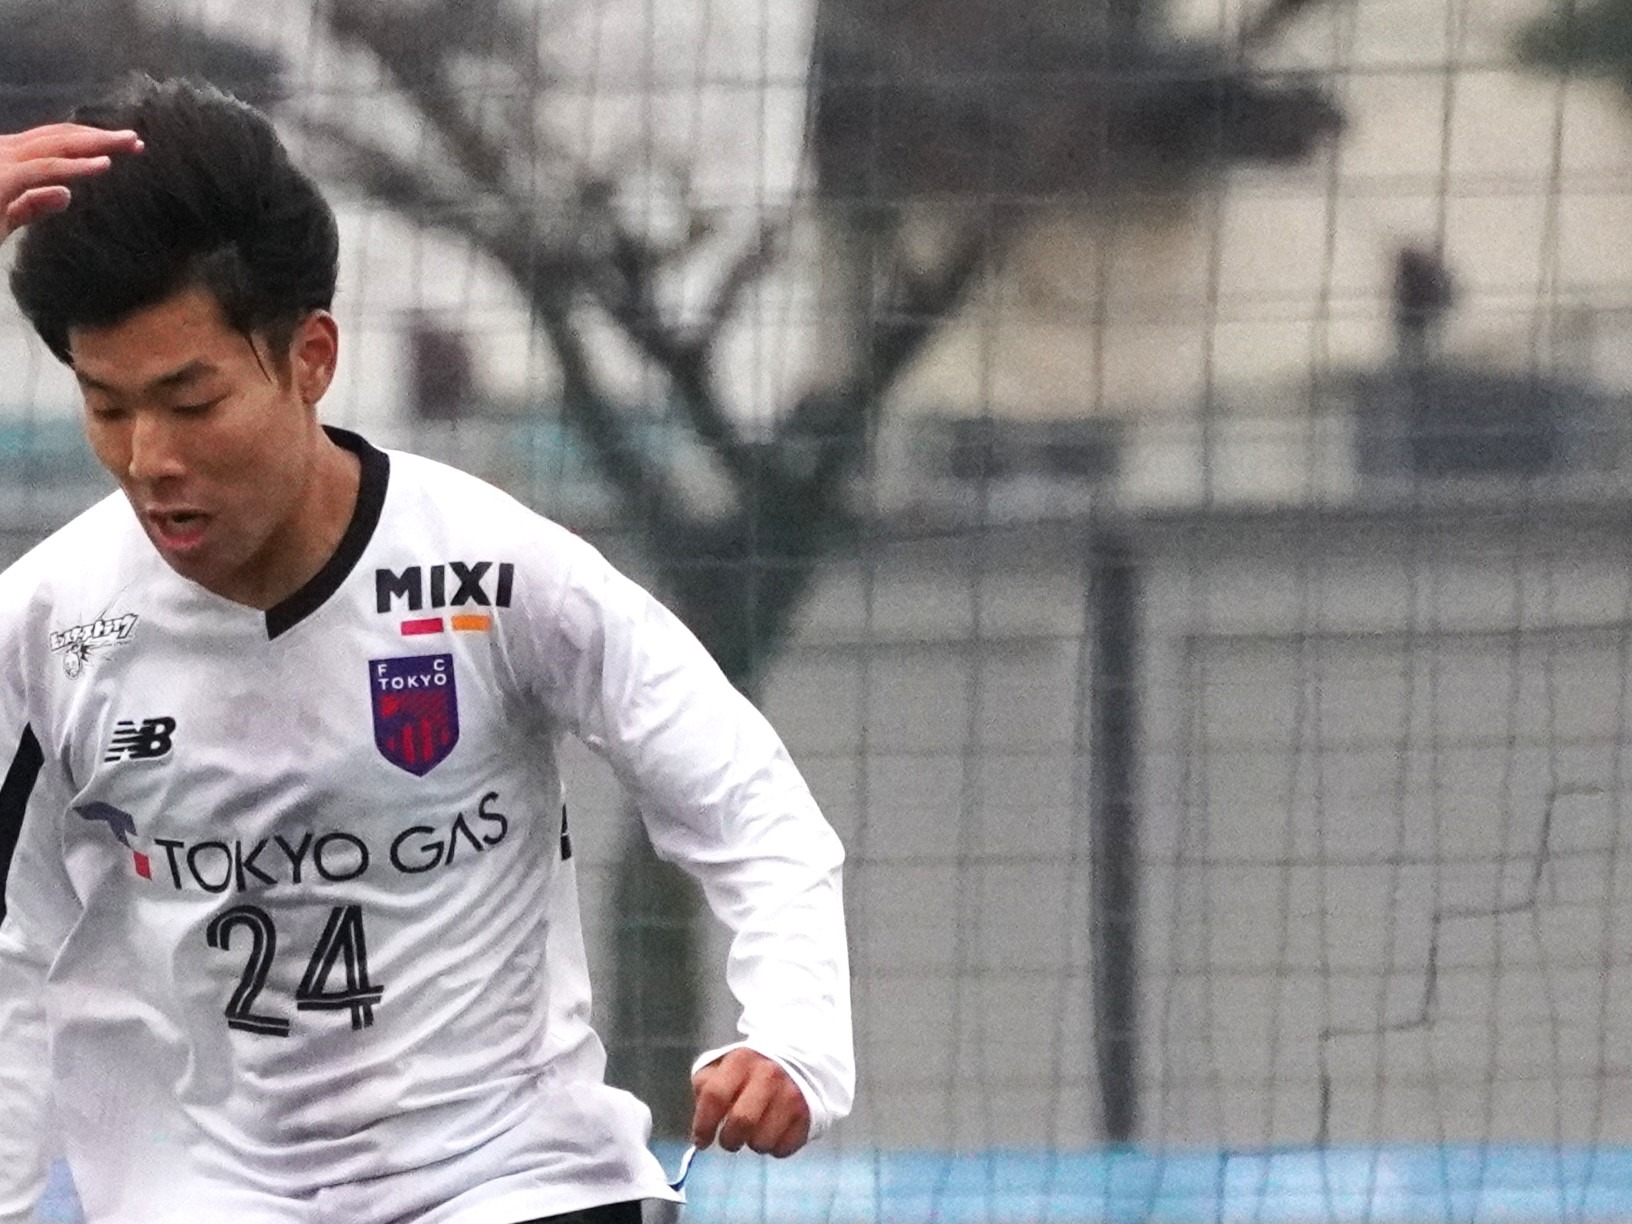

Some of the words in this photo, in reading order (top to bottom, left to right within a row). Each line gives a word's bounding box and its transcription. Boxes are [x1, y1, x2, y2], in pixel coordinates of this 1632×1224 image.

[375, 561, 515, 614] MIXI
[377, 664, 388, 677] F
[433, 659, 445, 671] C
[378, 674, 447, 691] TOKYO
[154, 832, 369, 893] TOKYO
[389, 791, 509, 874] GAS
[206, 904, 385, 1038] 24
